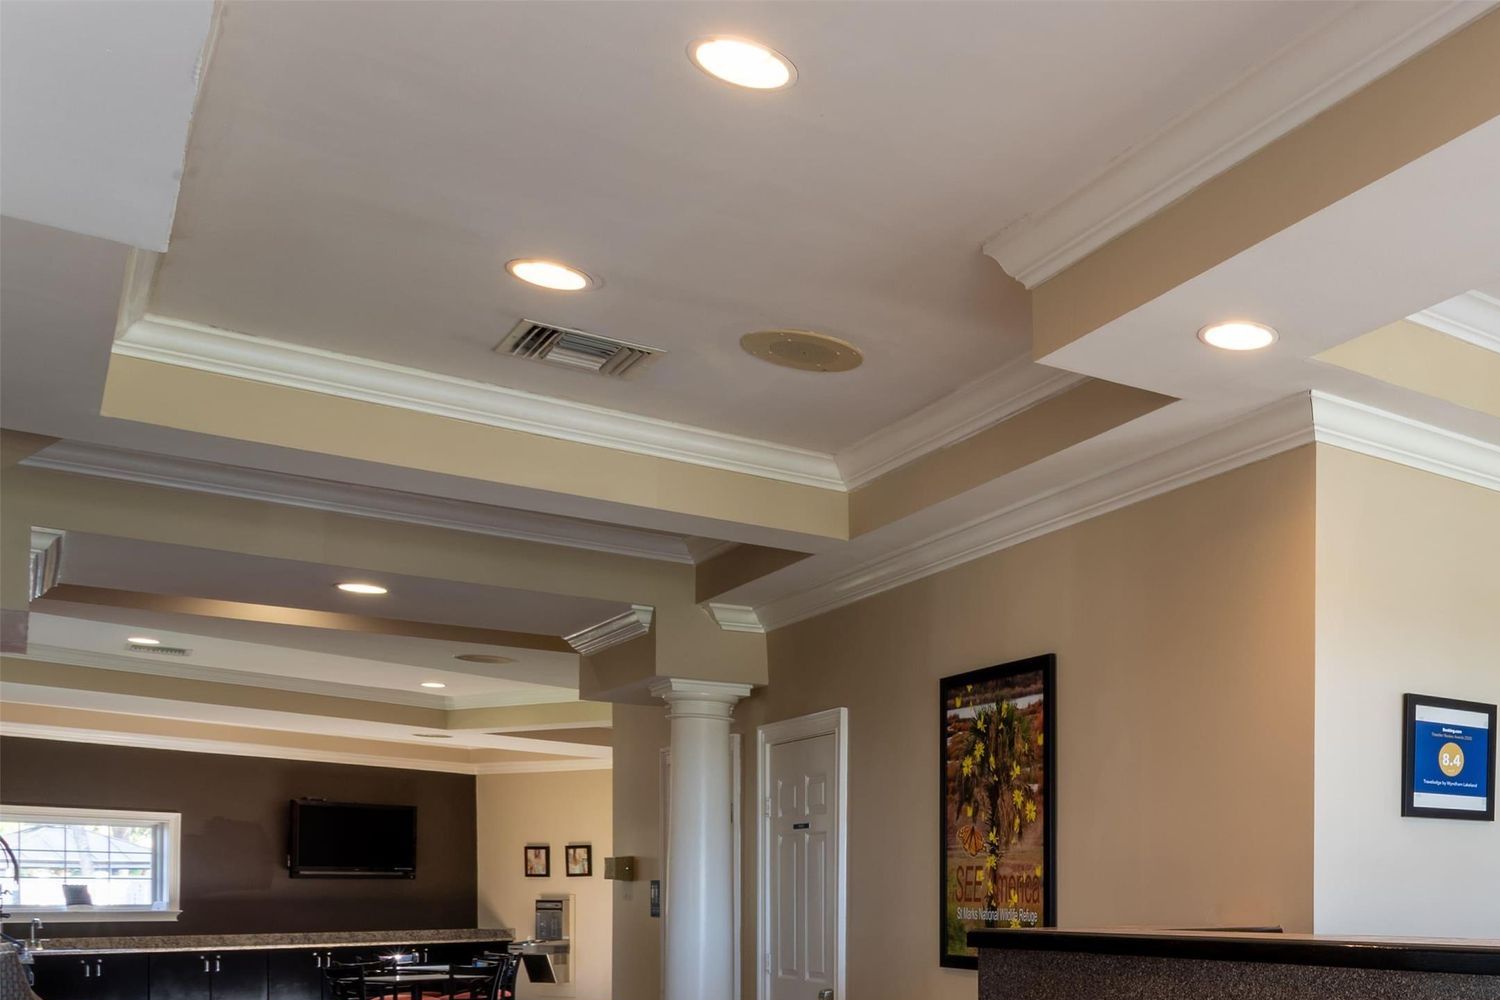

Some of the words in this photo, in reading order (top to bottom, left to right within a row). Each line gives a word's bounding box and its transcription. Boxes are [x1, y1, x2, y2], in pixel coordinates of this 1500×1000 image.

[1442, 753, 1461, 767] 8.4
[956, 866, 983, 902] SEE
[1018, 908, 1038, 926] Refuge
